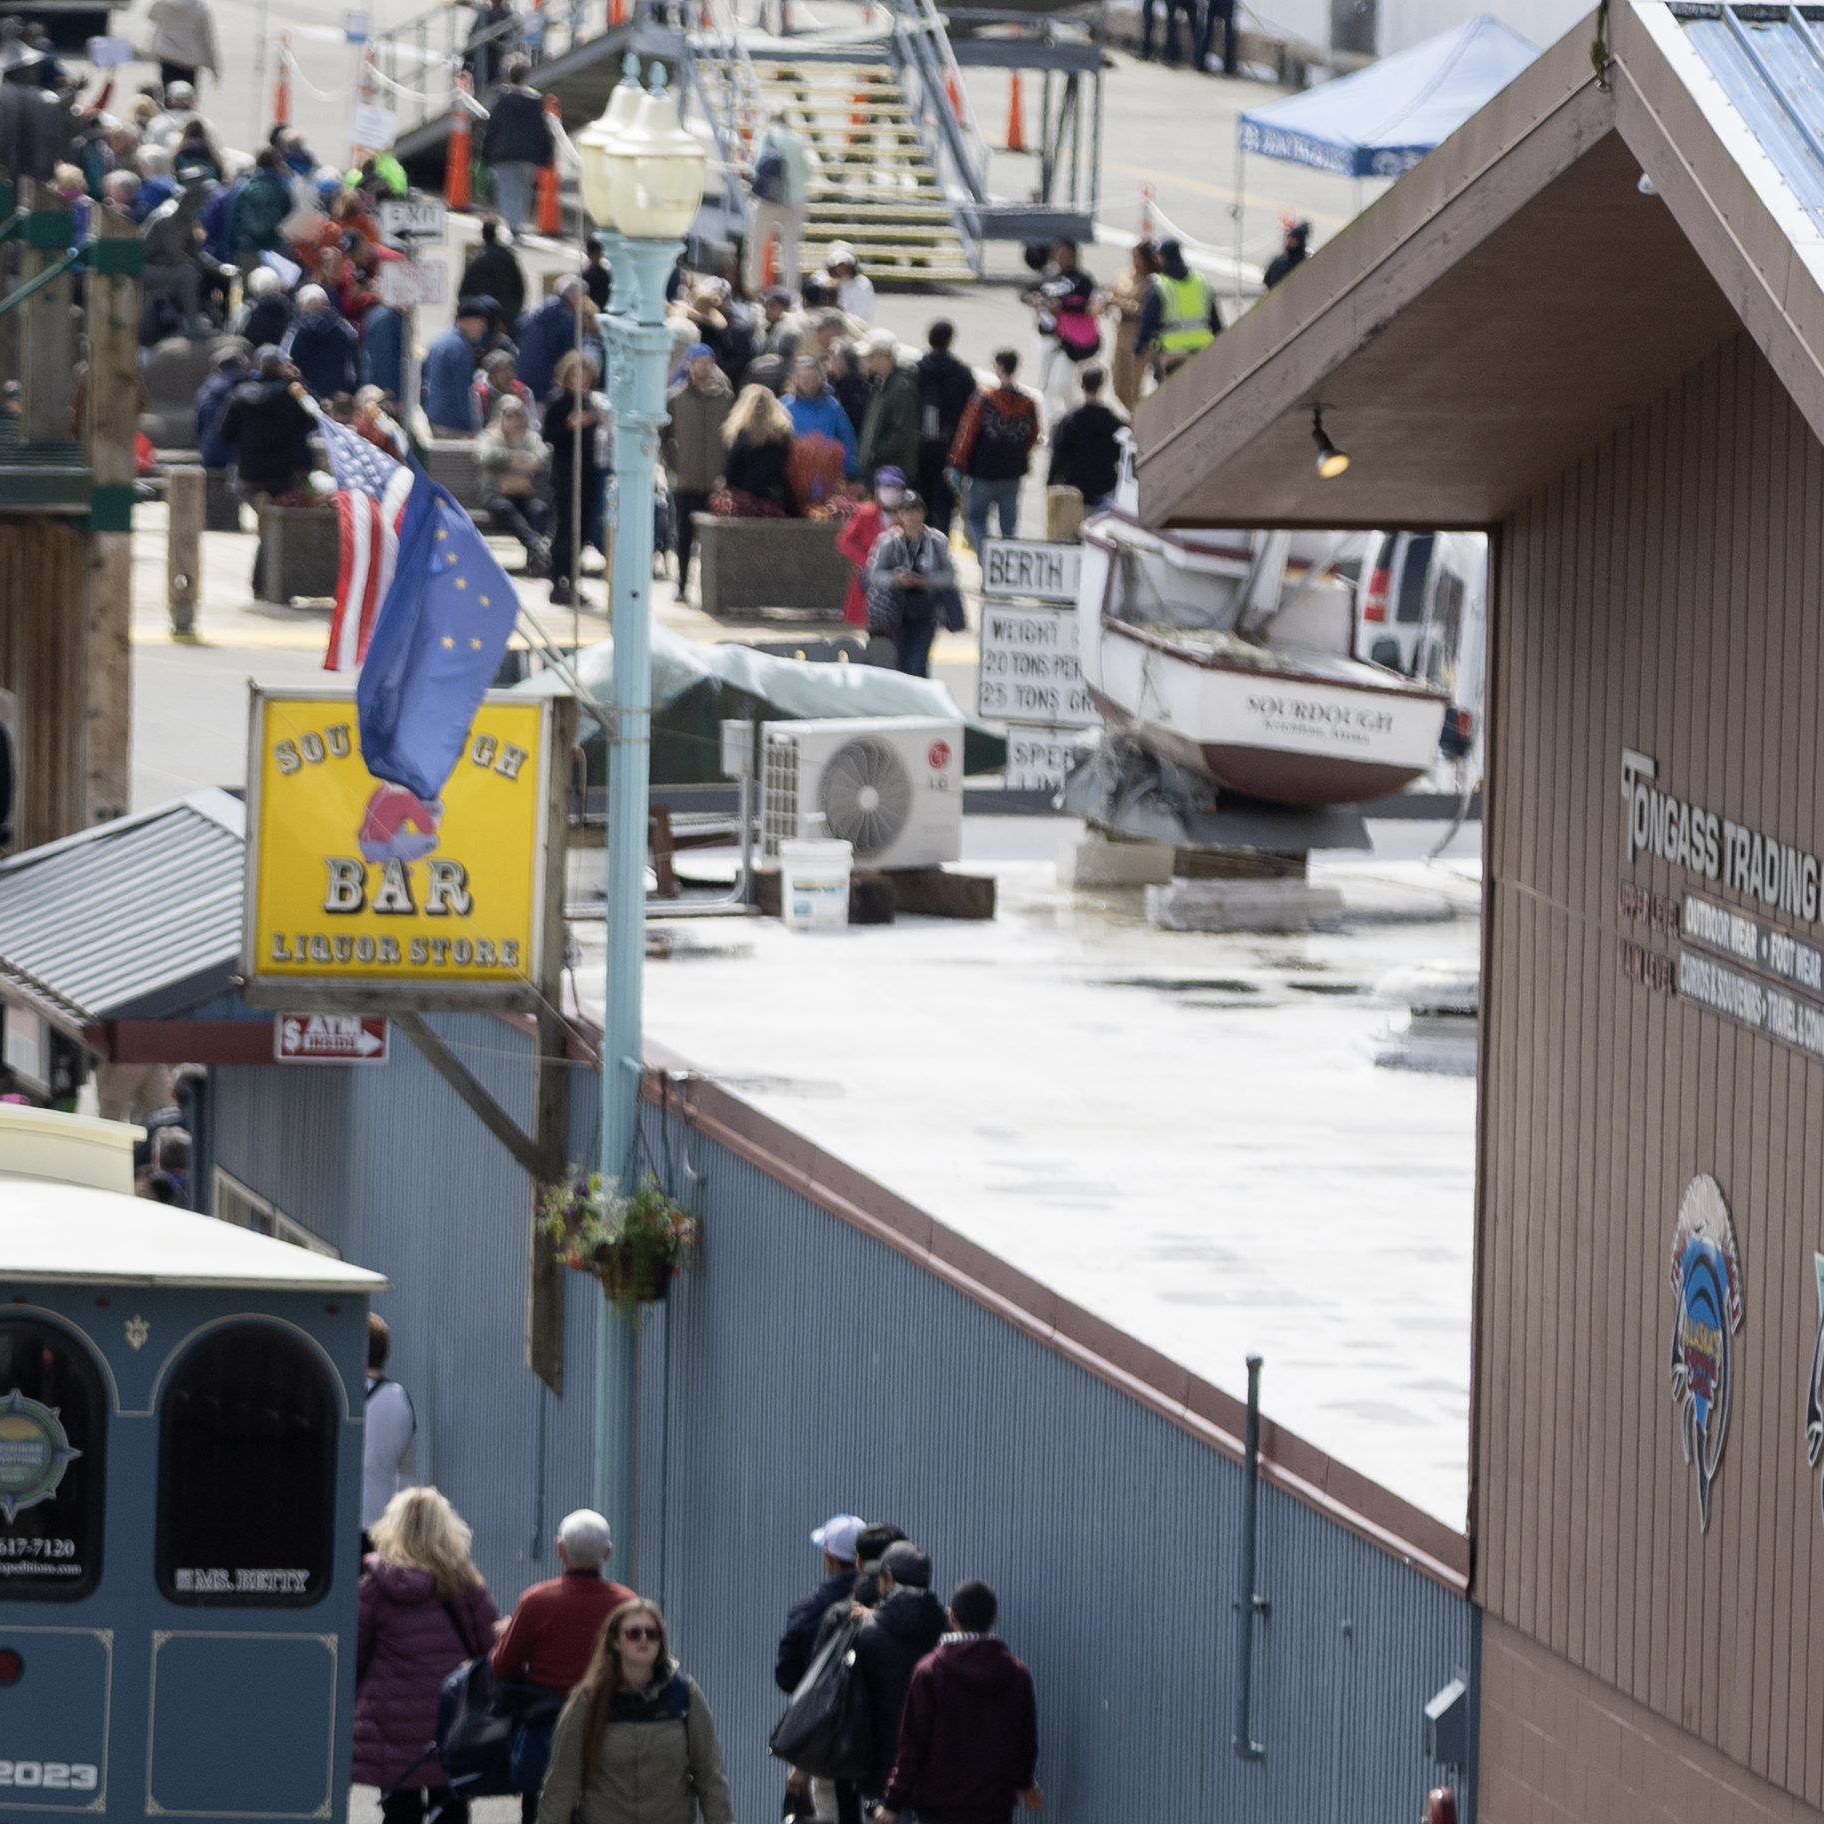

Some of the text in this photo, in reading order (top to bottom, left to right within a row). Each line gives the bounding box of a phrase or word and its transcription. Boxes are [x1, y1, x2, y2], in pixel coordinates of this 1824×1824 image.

[989, 548, 1064, 591] BERTH
[992, 617, 1059, 645] WEIGHT
[1012, 656, 1050, 677] TONS
[1014, 686, 1059, 711] TONS
[1248, 693, 1394, 734] SOURDOUGH
[1621, 747, 1819, 924] TONGASS TRADING
[323, 857, 477, 917] BAR
[271, 931, 521, 967] LIQUOR STORE
[1685, 894, 1822, 991] OUTDOOR WEAR FOOT WEAR
[305, 1013, 366, 1035] ATM
